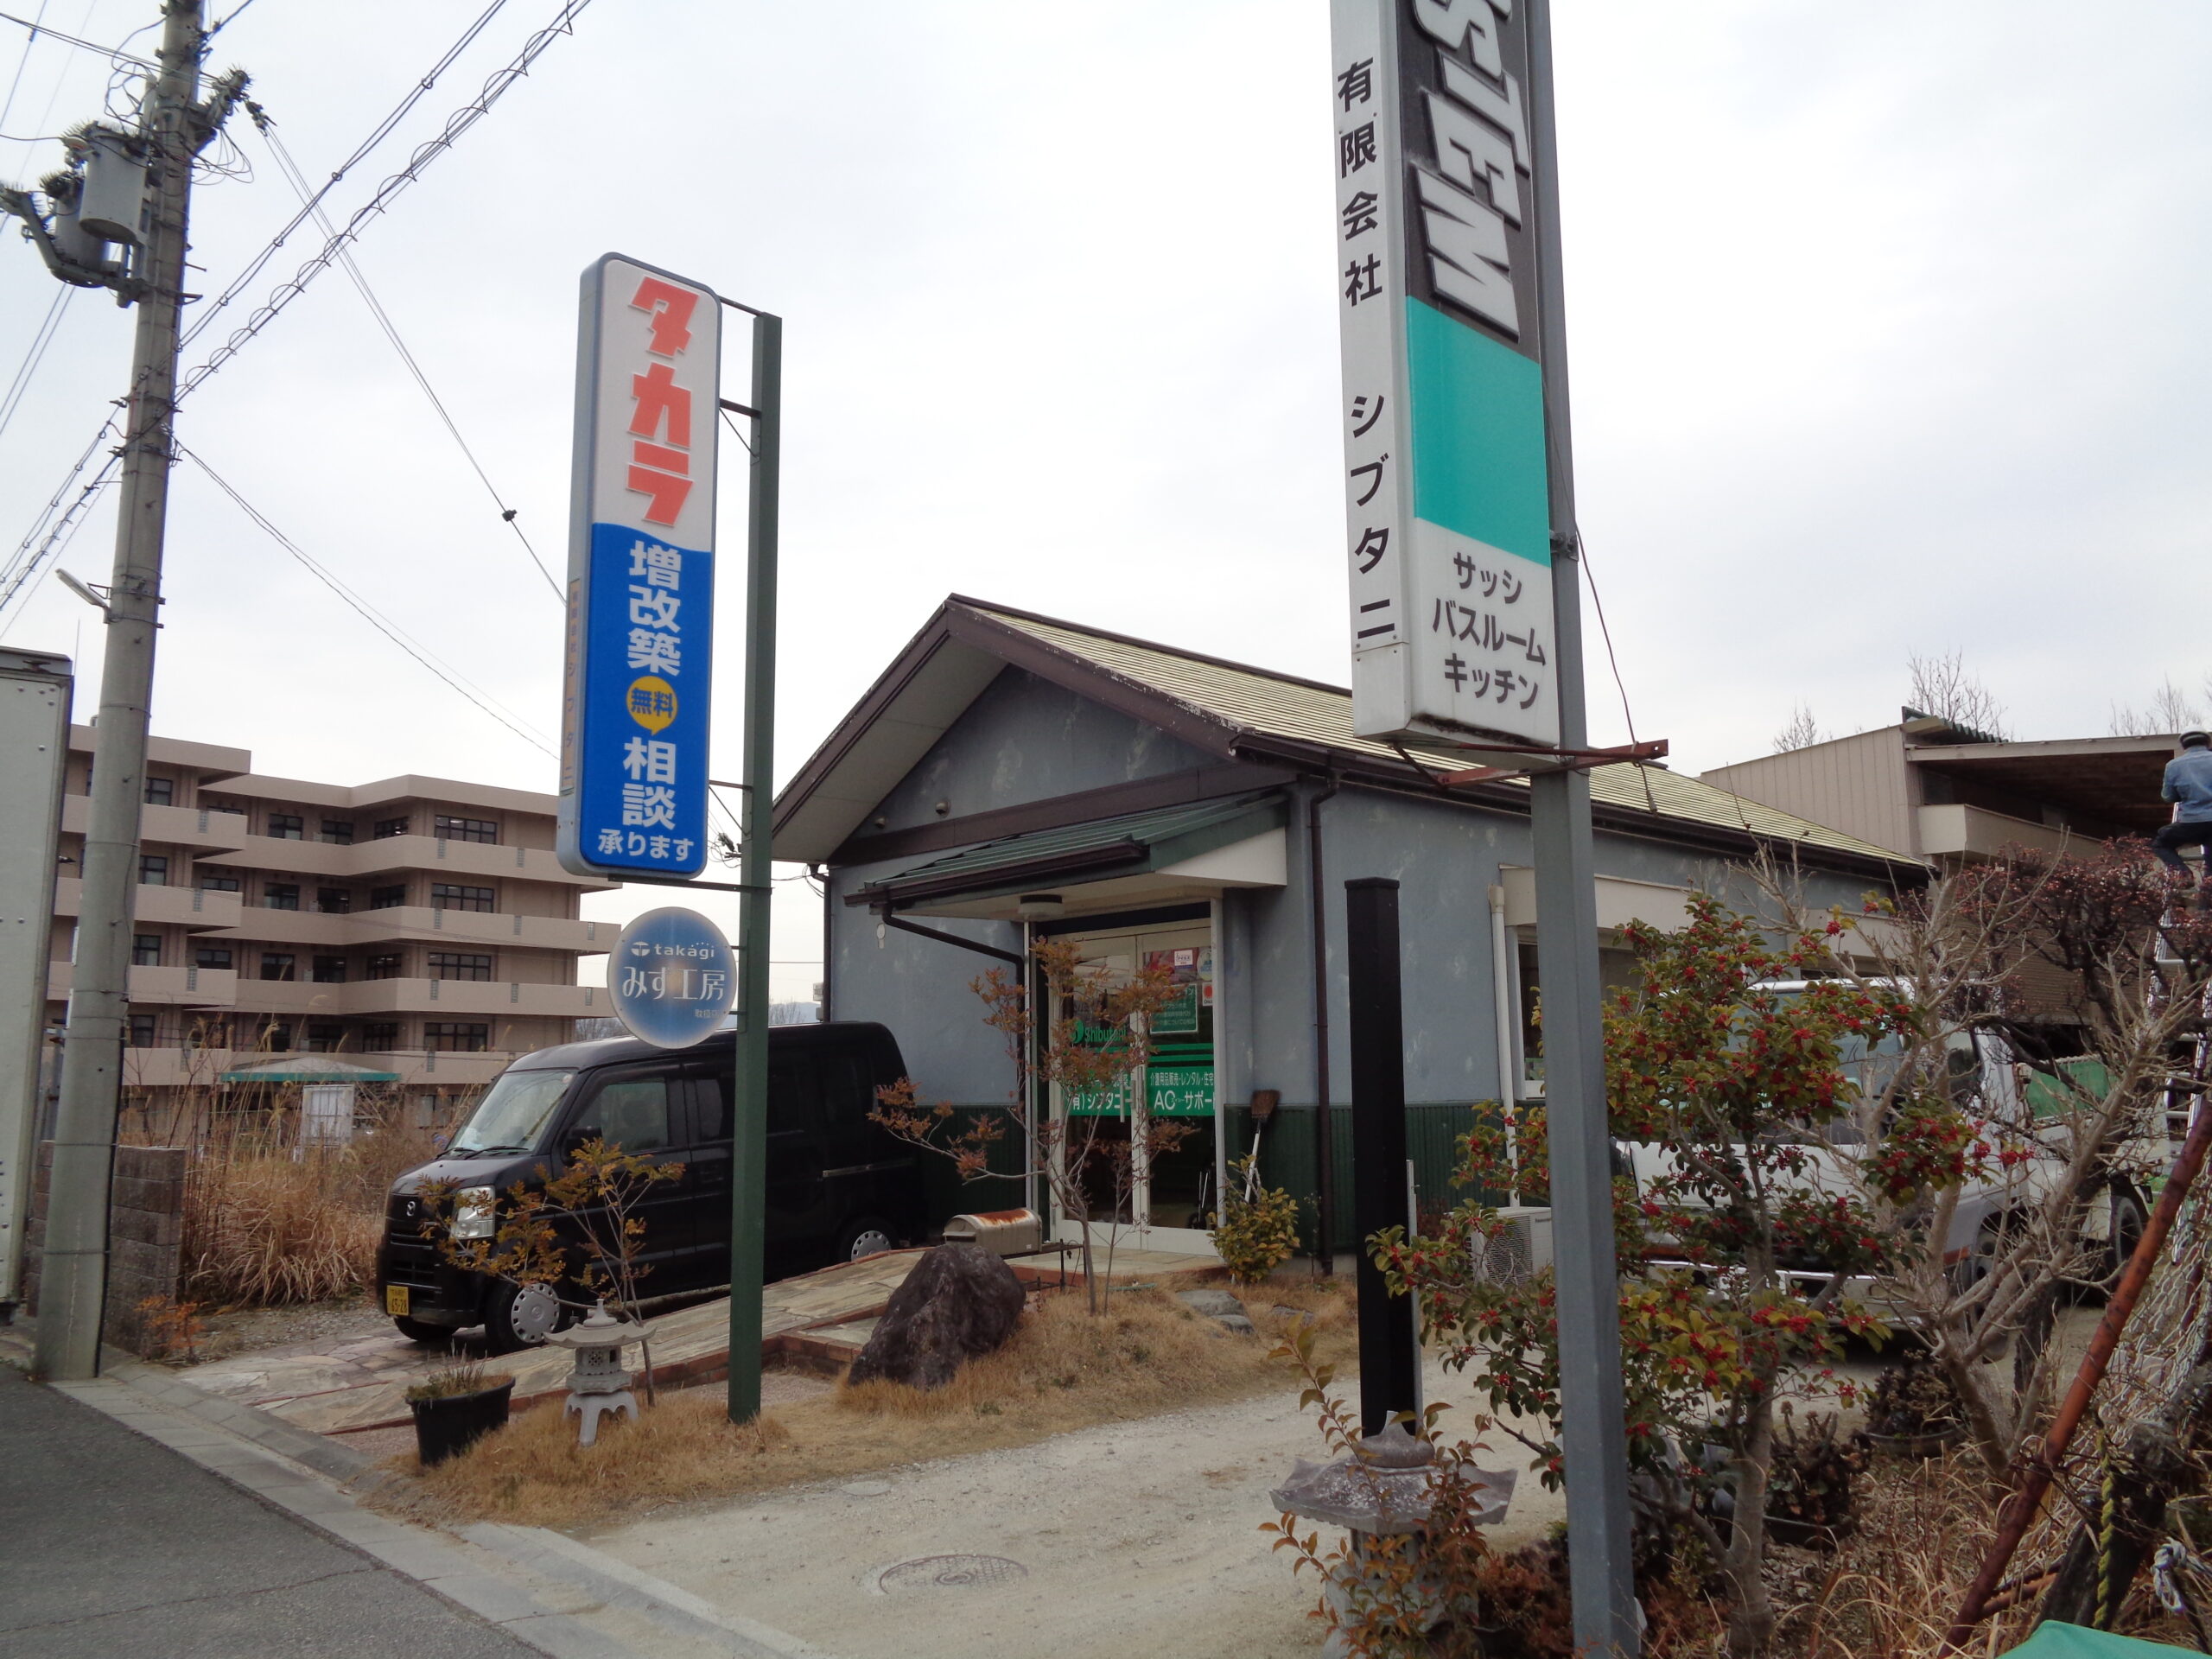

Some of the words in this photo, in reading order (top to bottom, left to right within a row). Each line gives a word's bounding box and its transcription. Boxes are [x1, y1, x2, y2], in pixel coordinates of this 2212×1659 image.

[1337, 57, 1382, 308] 有限会社
[1414, 0, 1530, 338] STEM
[626, 275, 700, 528] タカラ
[1350, 394, 1395, 640] シブタニ
[627, 539, 683, 677] 増改築
[1453, 551, 1522, 605] サッシ
[1433, 598, 1547, 667] バスルーム
[631, 688, 675, 719] 無料
[1444, 652, 1539, 710] キッチン
[622, 736, 677, 830] 相談
[597, 828, 694, 861] 承ります
[622, 966, 726, 1001] みす工房
[654, 944, 715, 960] takagi
